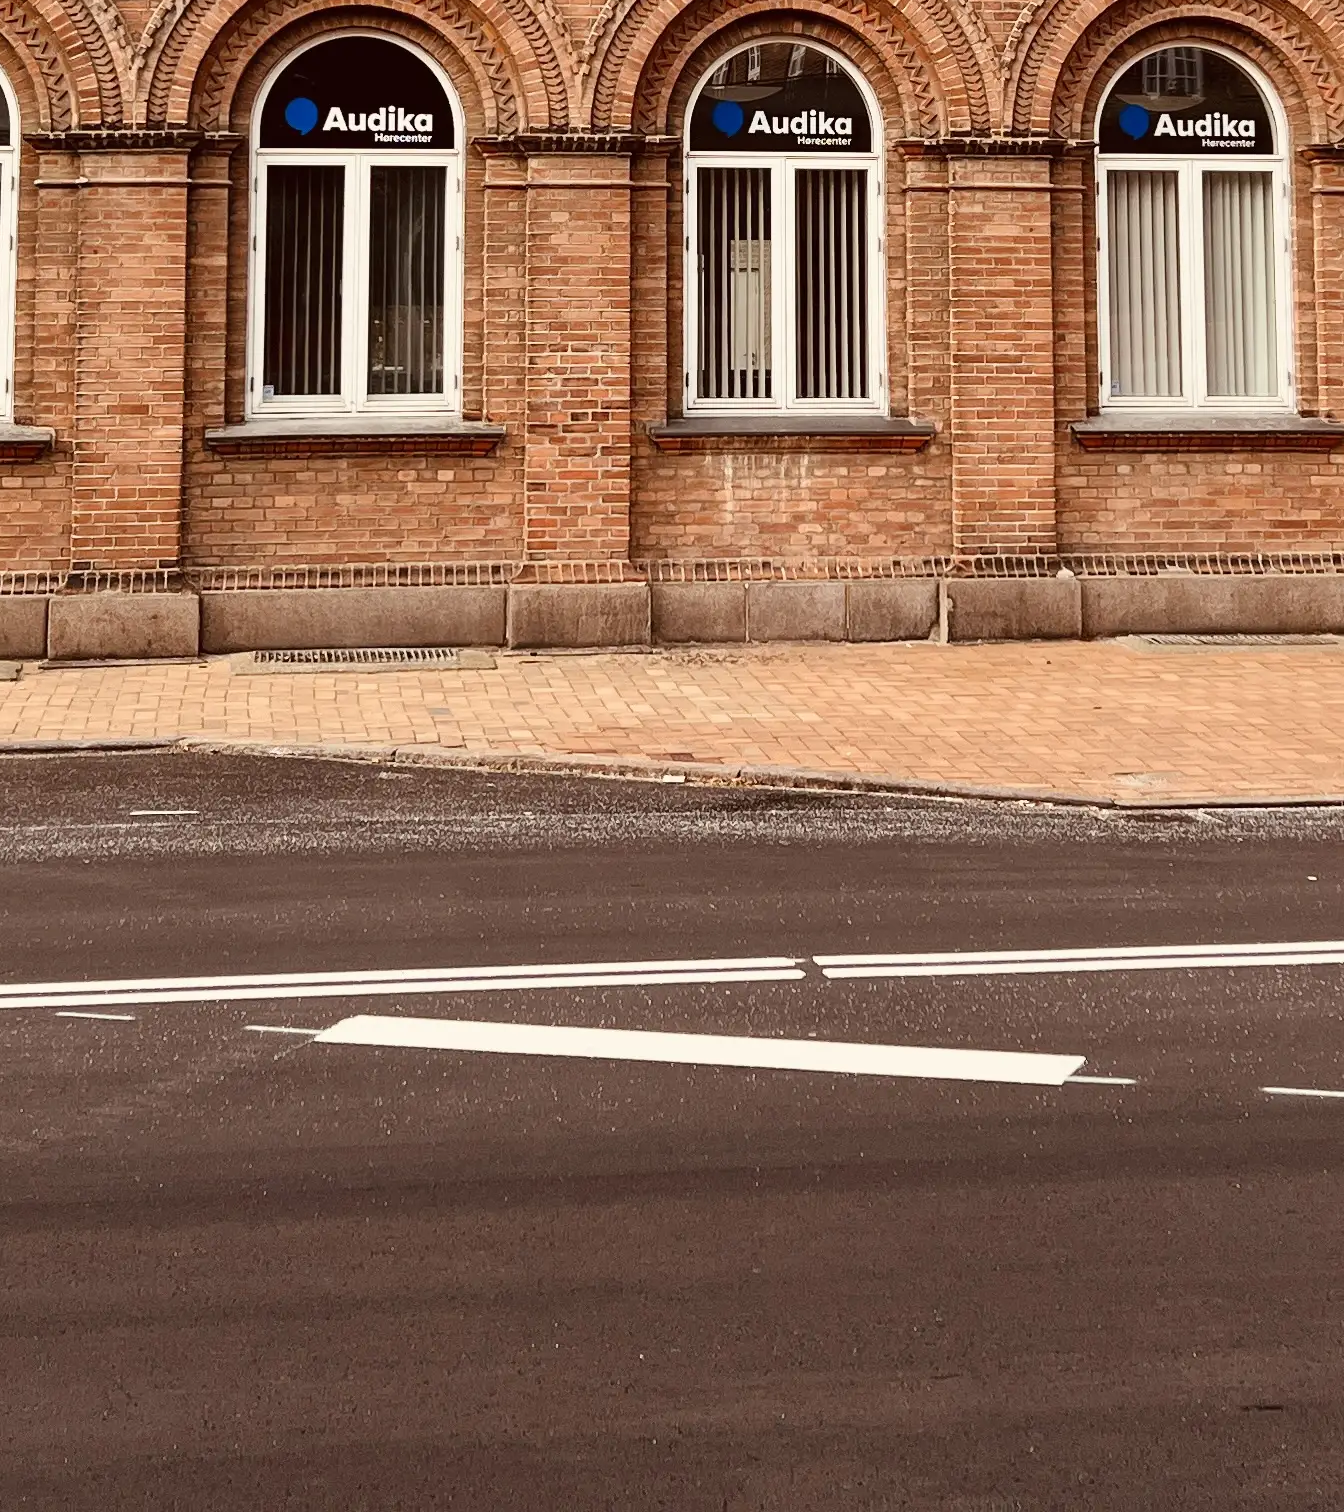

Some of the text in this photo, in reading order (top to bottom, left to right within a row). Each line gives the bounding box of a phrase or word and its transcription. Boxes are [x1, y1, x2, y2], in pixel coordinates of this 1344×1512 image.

[322, 105, 433, 132] Audika
[748, 109, 853, 135] Audika
[1153, 112, 1256, 138] Audika
